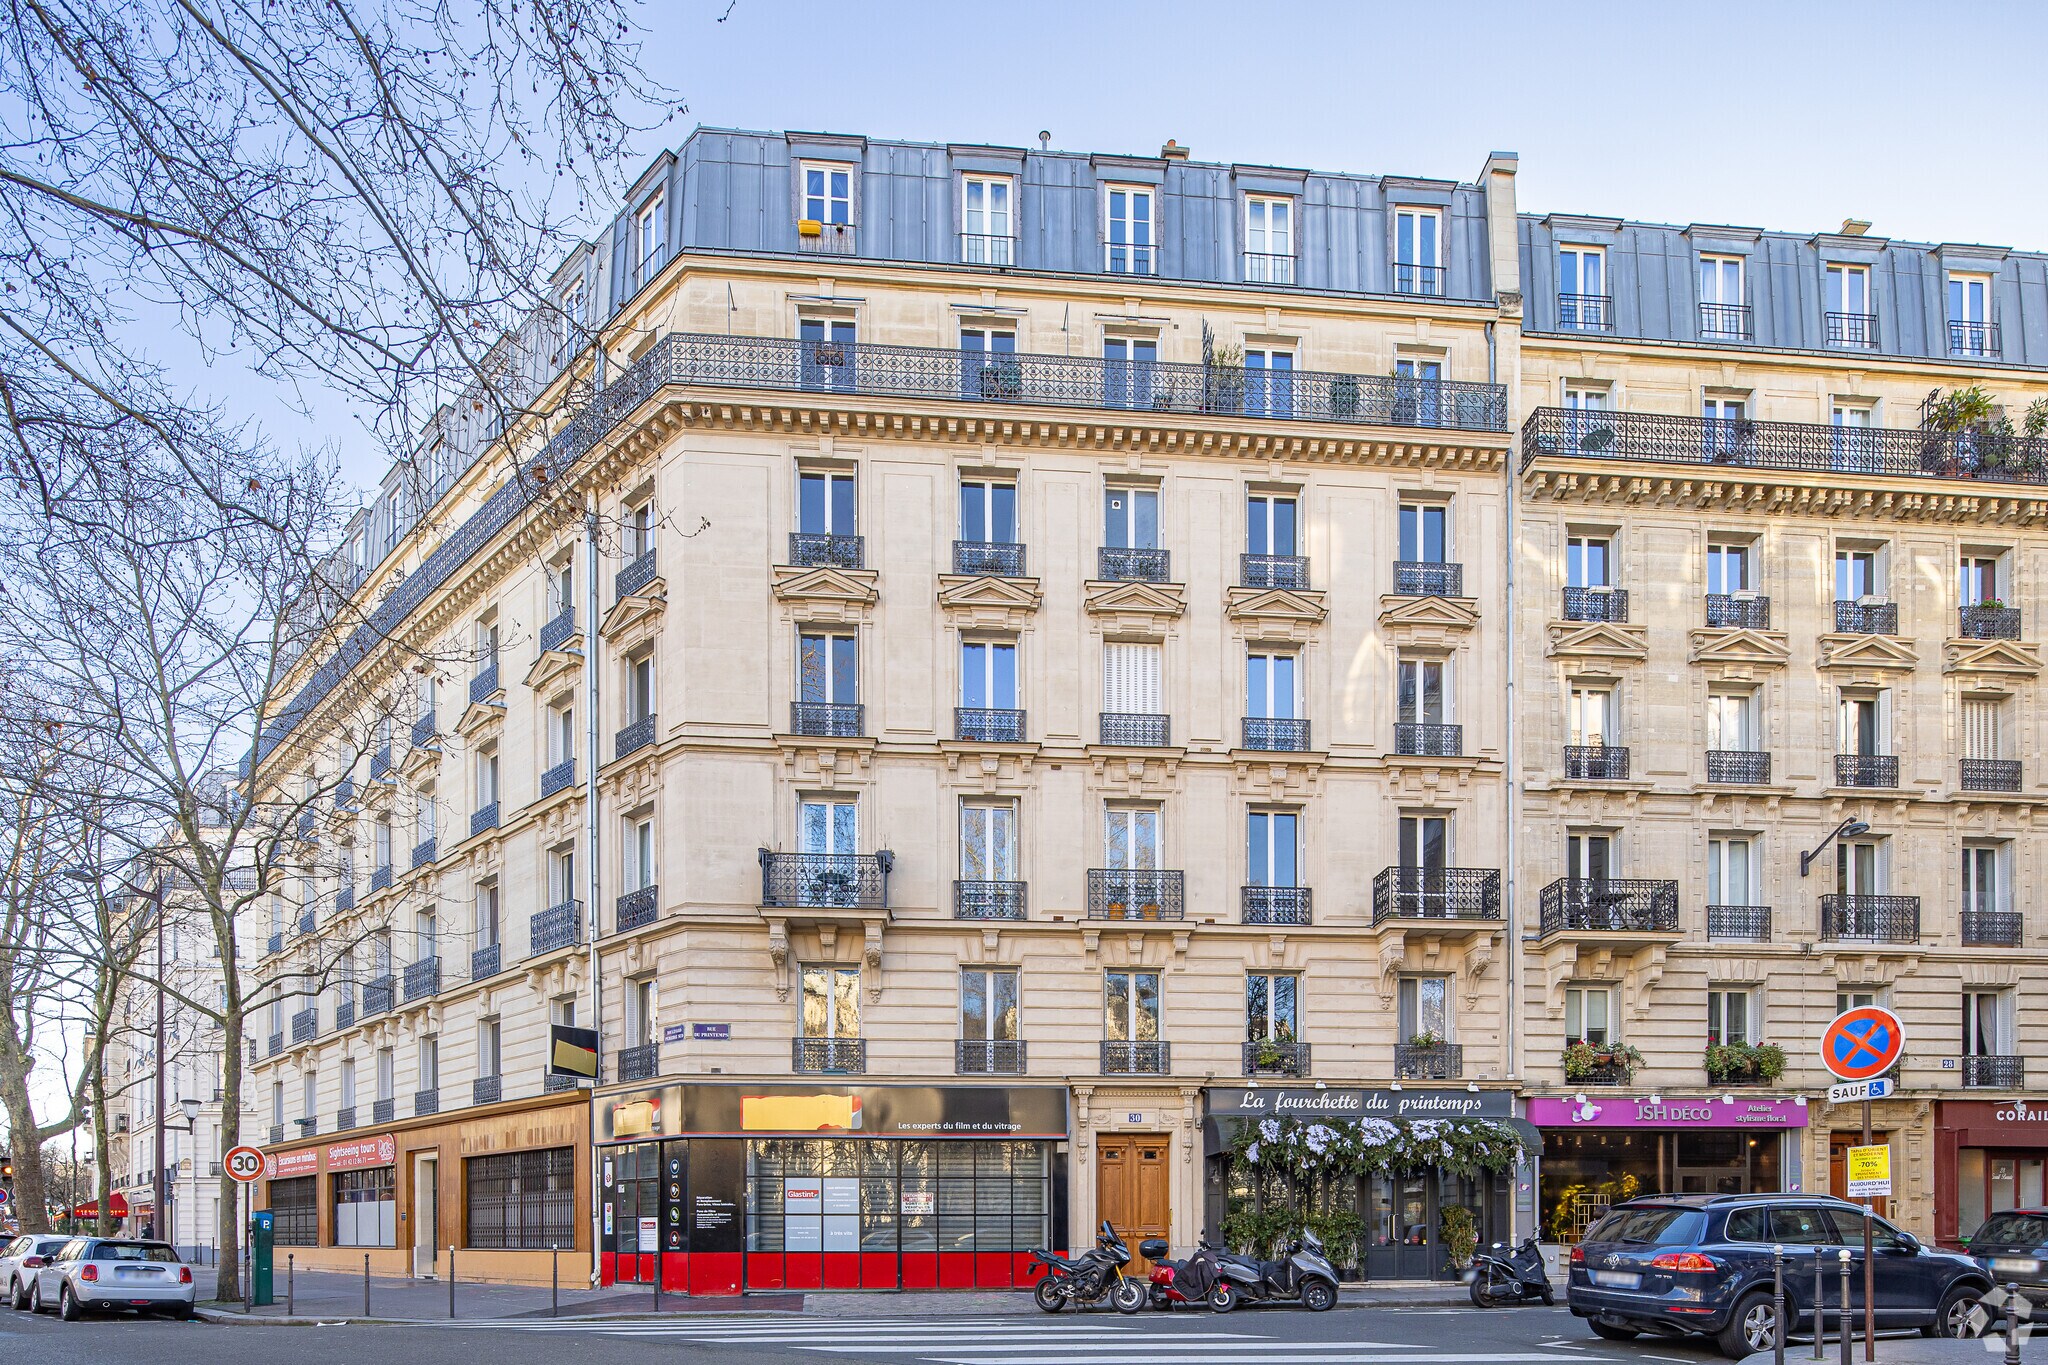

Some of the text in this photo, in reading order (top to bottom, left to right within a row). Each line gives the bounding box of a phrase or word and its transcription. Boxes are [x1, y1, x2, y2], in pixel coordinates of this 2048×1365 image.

[1943, 1060, 1953, 1068] 28
[1832, 1085, 1866, 1099] SAUF
[1240, 1091, 1482, 1114] La fourchette du printemps
[1130, 1114, 1140, 1122] 30
[1635, 1105, 1713, 1121] JSH DÉCO
[1735, 1114, 1787, 1122] stylisme floral
[1996, 1110, 2048, 1121] CORAIL
[912, 1122, 941, 1130] experts
[994, 1122, 1022, 1131] vitrage
[329, 1143, 376, 1161] Sightseeing tours
[233, 1156, 257, 1172] 30
[279, 1155, 297, 1166] Excursions
[302, 1151, 317, 1162] minibus
[262, 1220, 270, 1228] P
